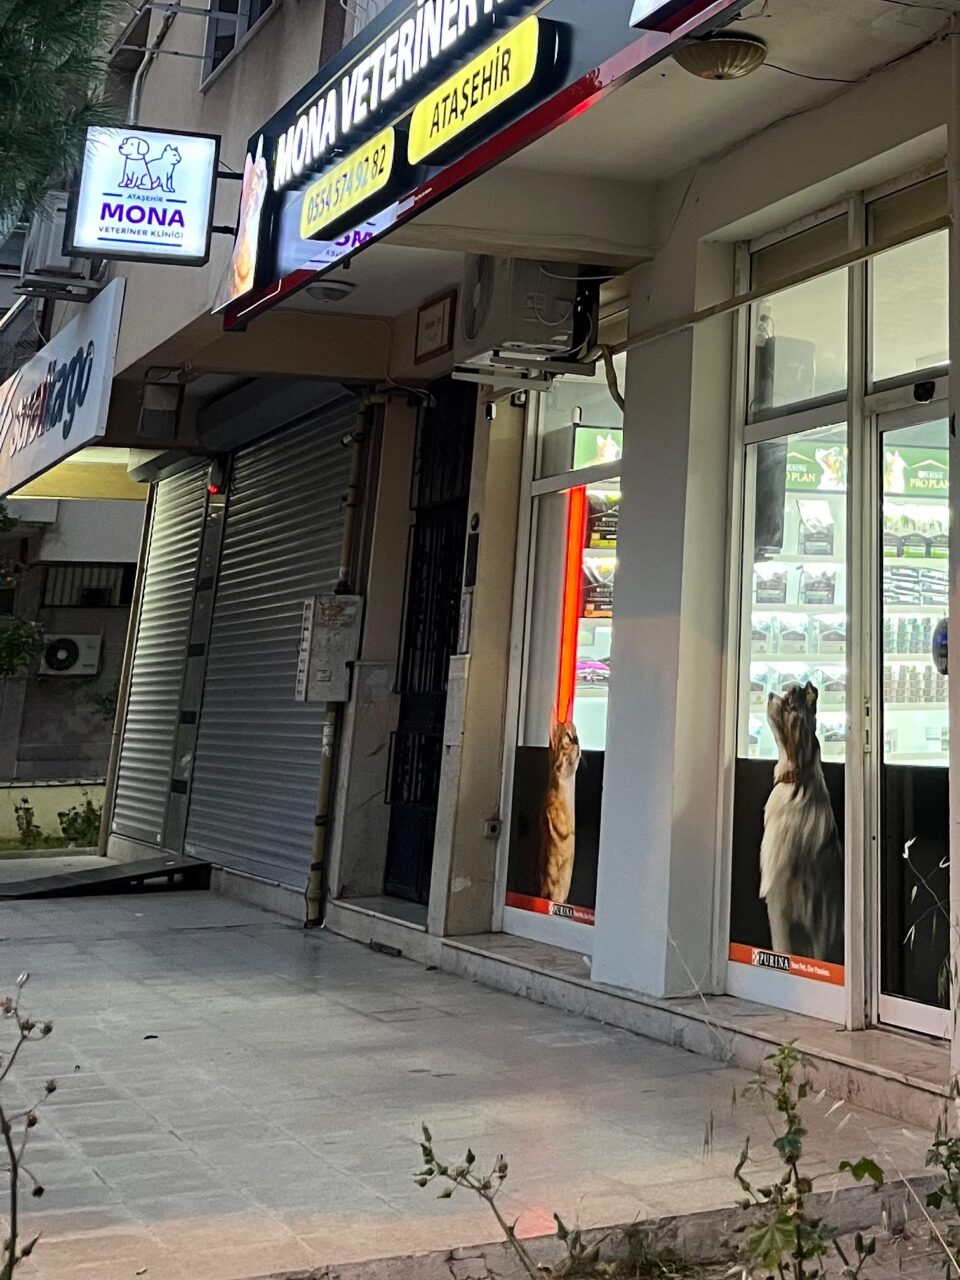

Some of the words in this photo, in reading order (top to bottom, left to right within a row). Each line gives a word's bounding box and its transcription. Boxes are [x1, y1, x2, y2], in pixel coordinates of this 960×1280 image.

[429, 45, 512, 139] ATAŞEHİR
[272, 87, 338, 193] MONA
[307, 181, 332, 226] 0554
[370, 143, 387, 181] 82
[98, 225, 148, 237] VETERİNER
[100, 202, 186, 229] MONA
[760, 953, 789, 970] PURINA
